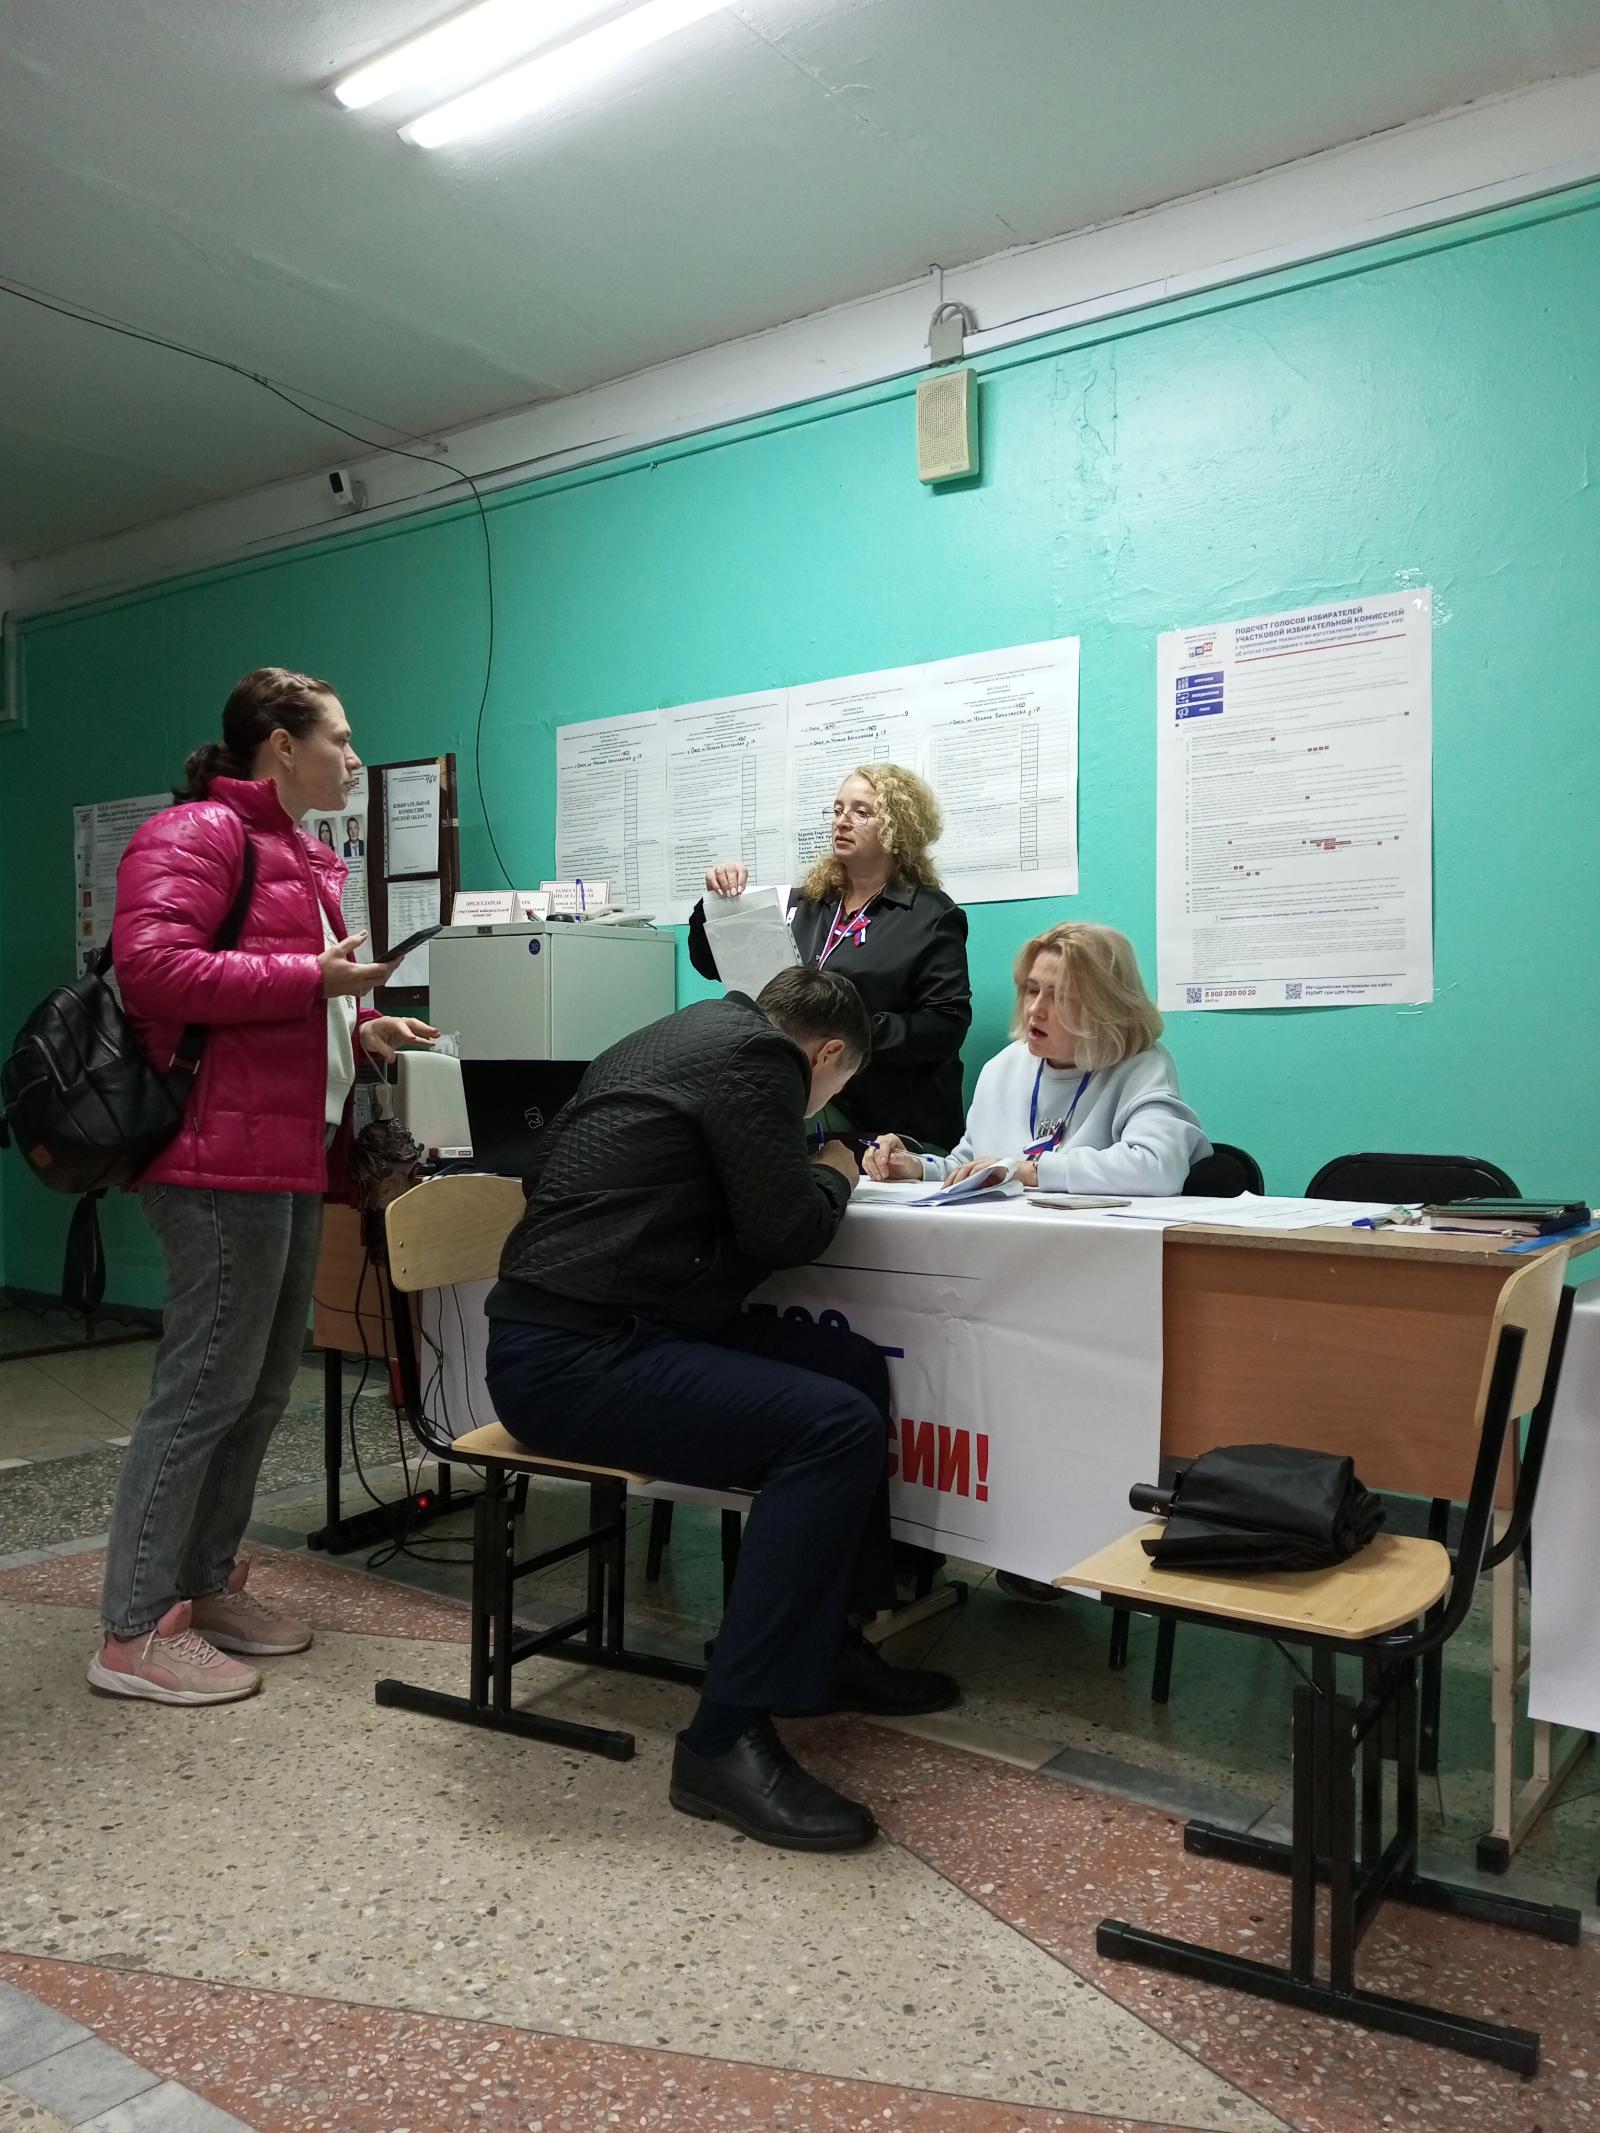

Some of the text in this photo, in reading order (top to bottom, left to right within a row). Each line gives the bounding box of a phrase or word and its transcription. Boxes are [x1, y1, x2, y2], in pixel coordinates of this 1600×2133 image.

[1235, 606, 1363, 634] ПОДСЧЕТ ГОЛОСОВ ИЗБИРАТЕЛЕЙ
[1235, 608, 1405, 643] УЧАСТКОВОЙ ИЗБИРАТЕЛЬНОЙ КОМИССИЕЙ
[392, 800, 430, 808] ИЗБИРАТЕЛЬНАЯ
[411, 813, 432, 821] ОБЛАСТИ
